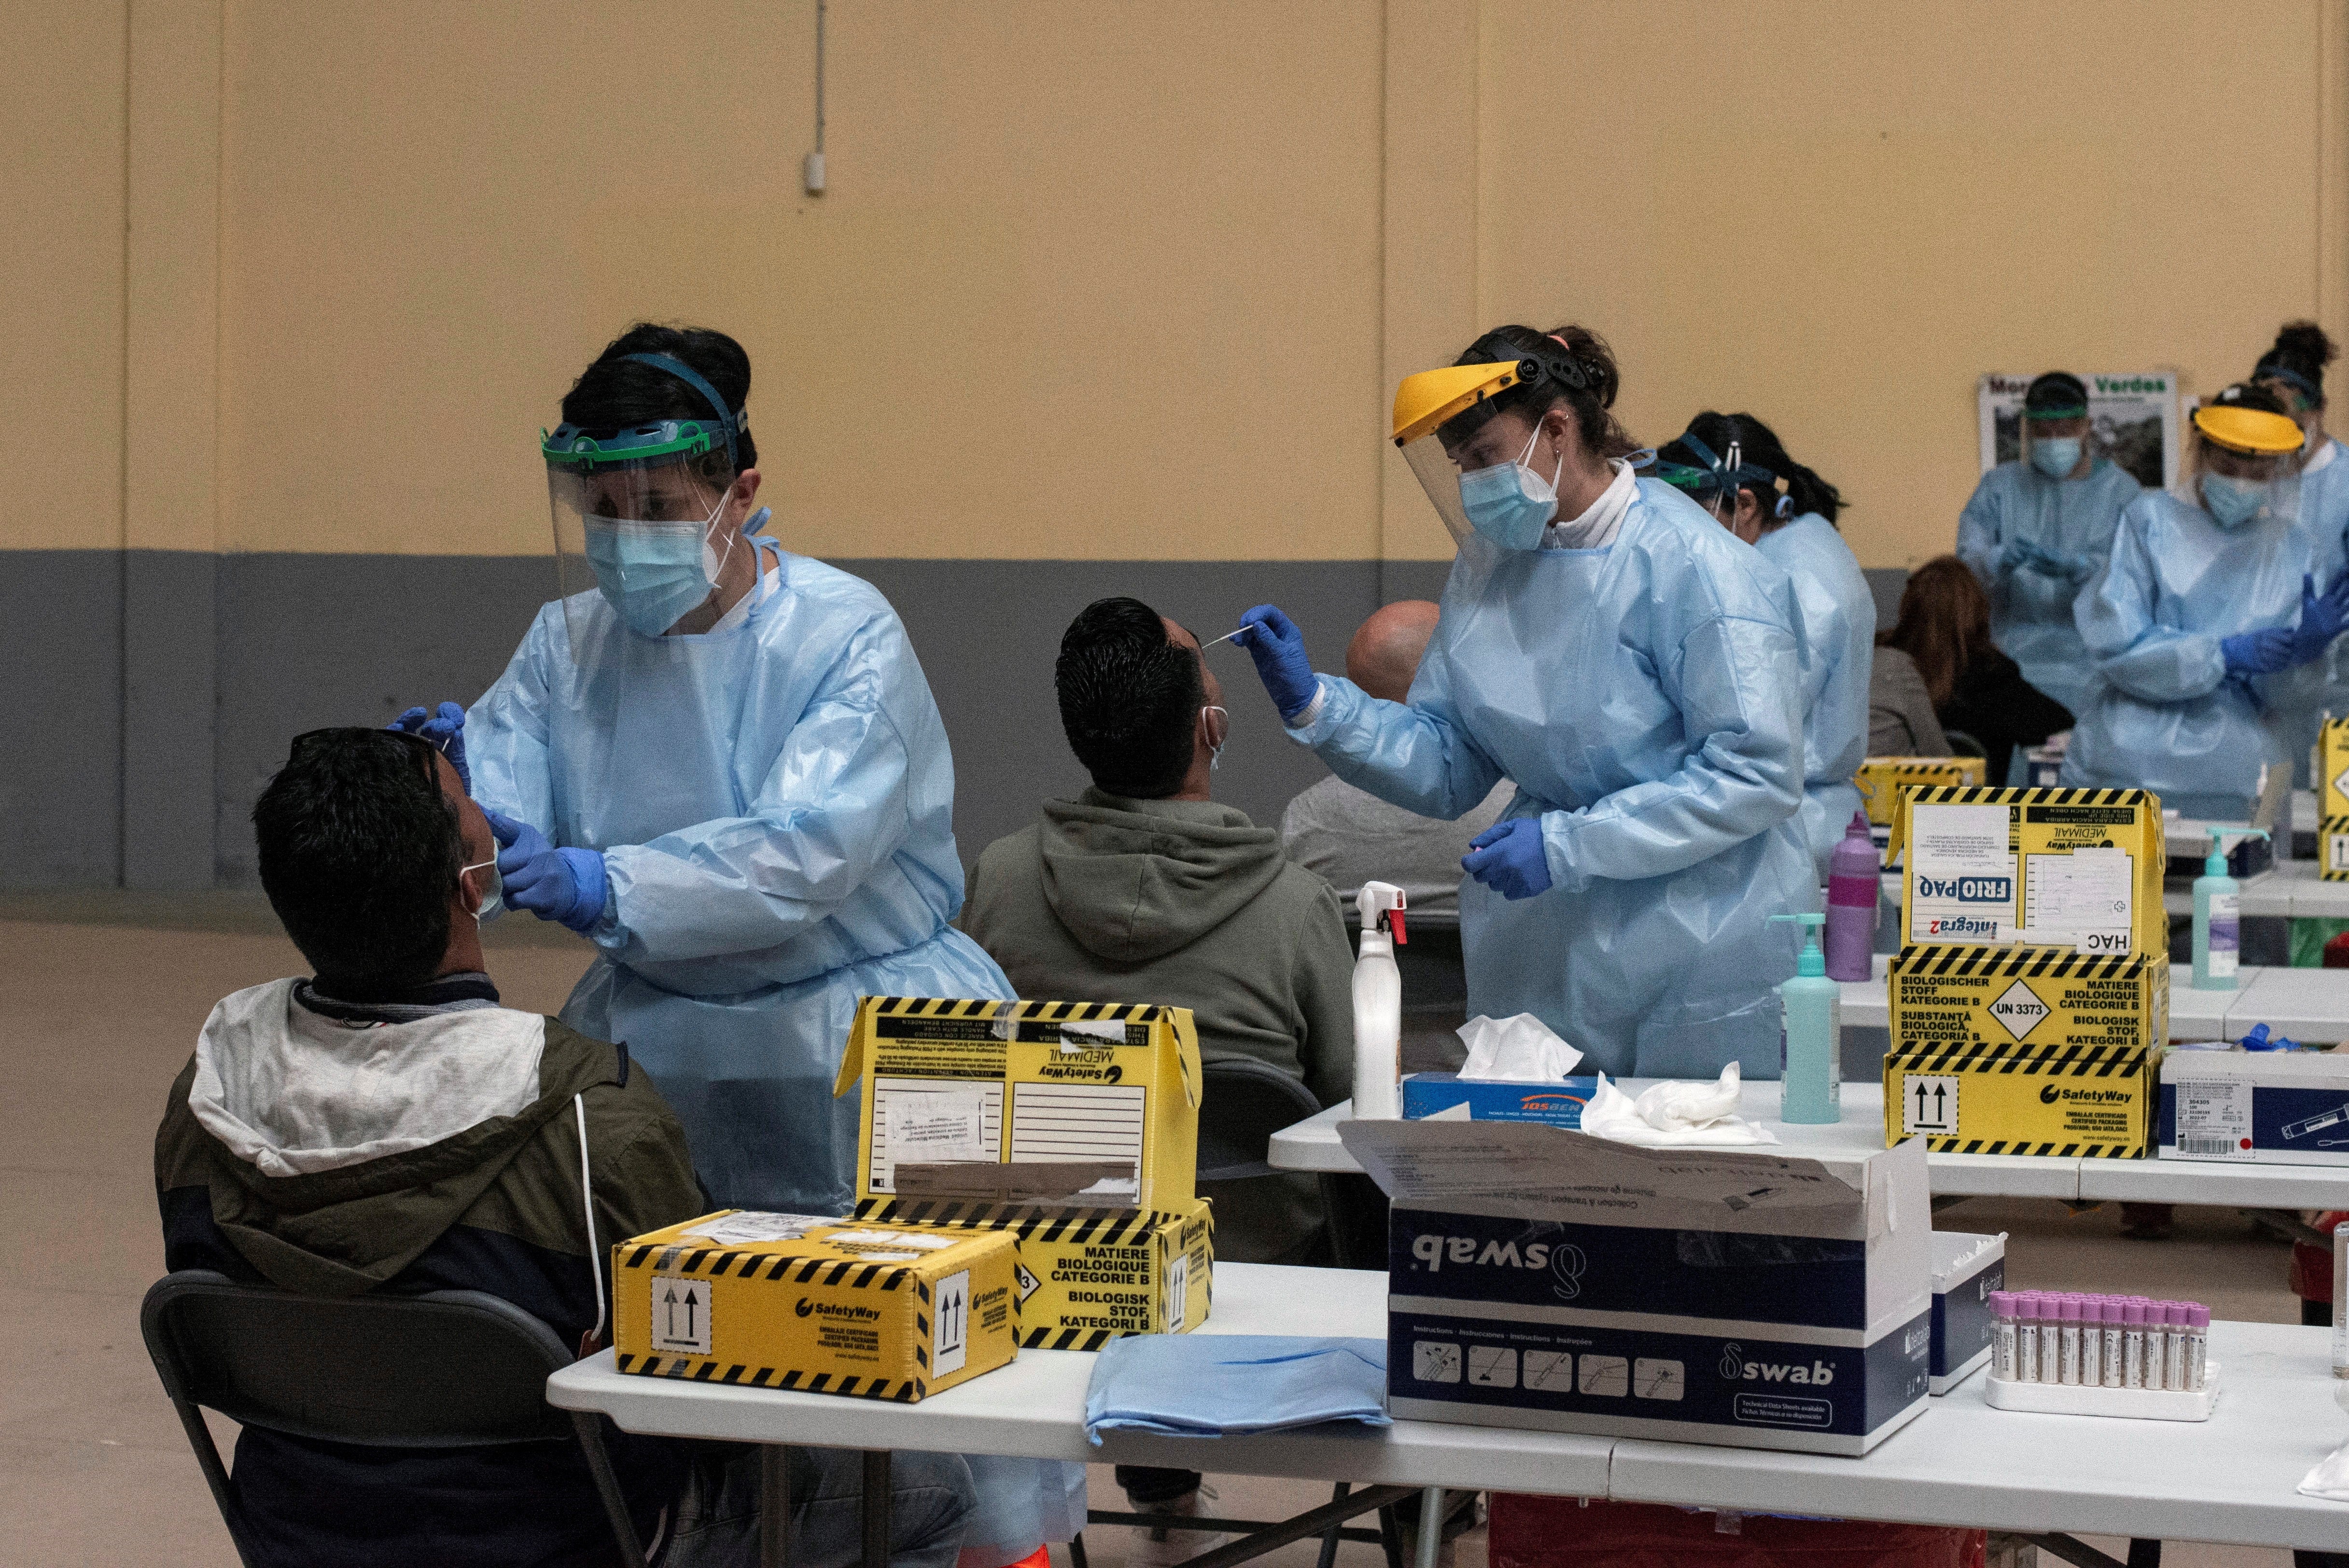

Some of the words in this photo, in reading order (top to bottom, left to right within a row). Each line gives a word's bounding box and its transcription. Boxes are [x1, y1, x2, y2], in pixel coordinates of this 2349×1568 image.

[2096, 377, 2166, 392] Verdes
[2054, 828, 2107, 838] MEDIMAIL
[1919, 876, 1957, 897] PAQ
[1962, 881, 2006, 898] FRIO
[1930, 917, 1997, 939] integra2
[2088, 935, 2126, 949] HAC
[1902, 977, 1989, 986] BIOLOGISCHER
[2087, 981, 2139, 990] MATIERE
[1902, 986, 1938, 994] STOFF
[2065, 990, 2139, 1000] BIOLOGIQUE
[1902, 996, 1969, 1006] KATEGORIE
[2060, 1000, 2127, 1009] CATEGORIE
[1997, 1004, 2013, 1014] UN
[2016, 1004, 2042, 1015] 3373
[2074, 1016, 2139, 1025] BIOLOGISK
[1902, 1031, 1969, 1041] CATEGORIA
[2107, 1027, 2139, 1036] STOF,
[2067, 1036, 2126, 1045] KATEGORI
[1049, 1049, 1114, 1063] MEDIMAIL
[1039, 1066, 1102, 1079] SafetyWay
[2062, 1089, 2132, 1103] SafetyWay
[1597, 1200, 1637, 1209] Collection
[1085, 1247, 1149, 1260] MATIERE
[1058, 1259, 1149, 1272] BIOLOGIQUE
[1051, 1271, 1135, 1284] CATEGORIE
[1140, 1275, 1149, 1285] B
[1069, 1291, 1149, 1304] BIOLOGISK
[816, 1303, 881, 1320] SafetyWay
[1110, 1306, 1149, 1319] STOF,
[1061, 1316, 1134, 1329] KATEGORI
[1140, 1319, 1149, 1330] B
[1413, 1326, 1453, 1334] Instructions
[1459, 1329, 1504, 1339] Instrucciones
[1510, 1333, 1551, 1342] Instructions
